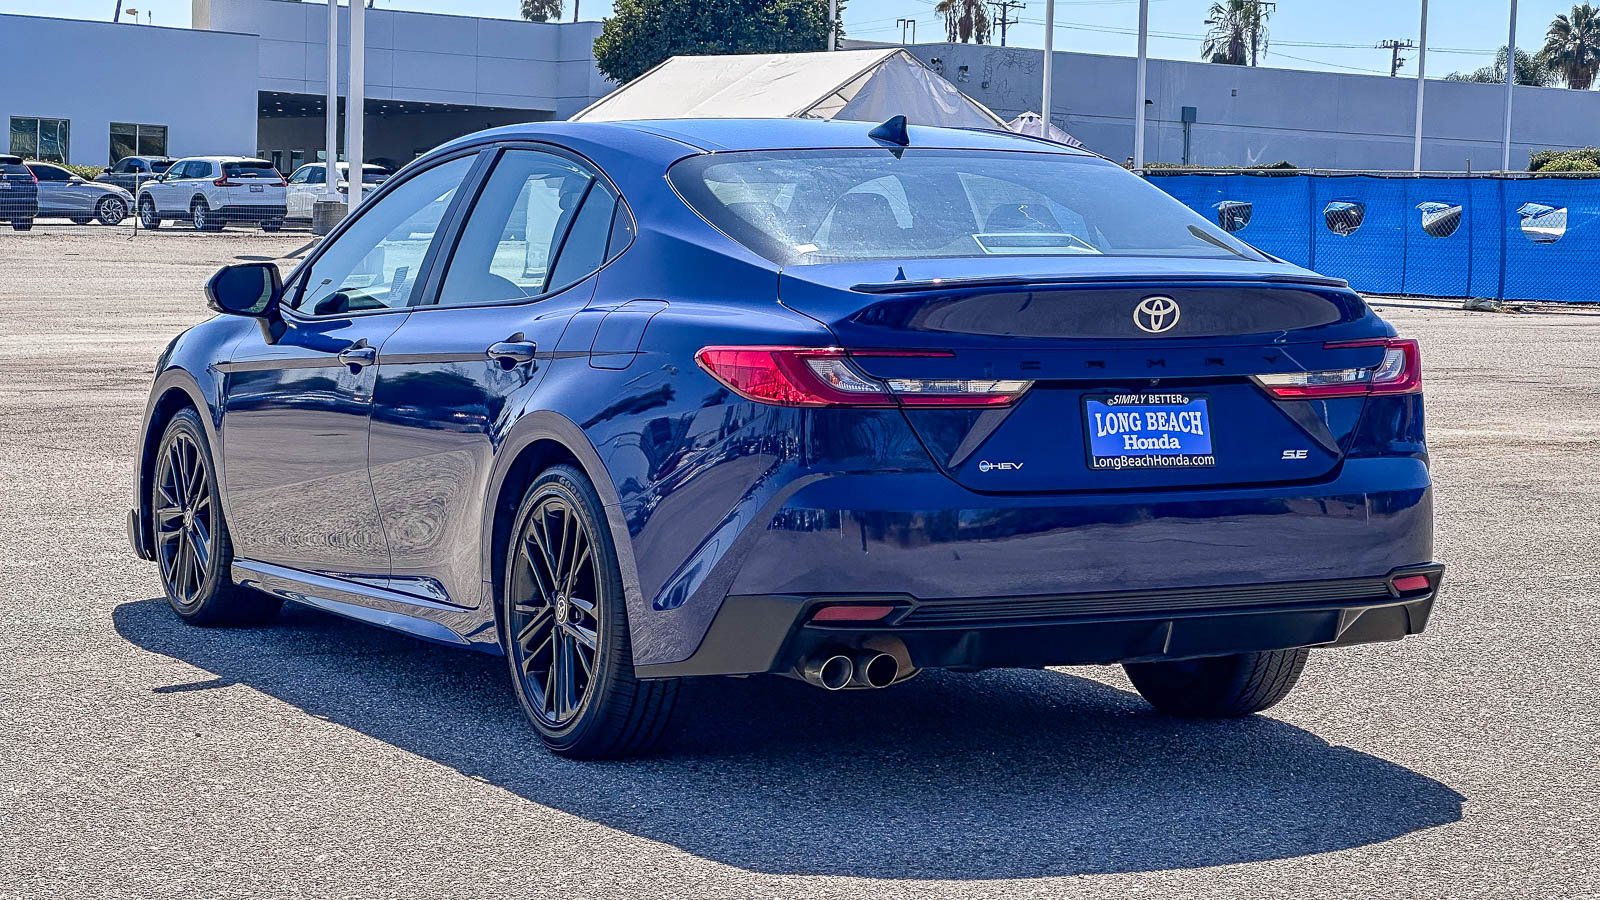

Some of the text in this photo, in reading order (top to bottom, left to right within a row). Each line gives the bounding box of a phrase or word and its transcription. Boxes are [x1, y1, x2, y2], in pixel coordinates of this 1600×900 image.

[1113, 394, 1183, 405] SIMPLY BETTER
[1095, 411, 1204, 437] LONG BEACH
[1123, 433, 1181, 450] Honda
[1093, 453, 1215, 470] LongBeachHonda.com
[1281, 449, 1309, 460] SE
